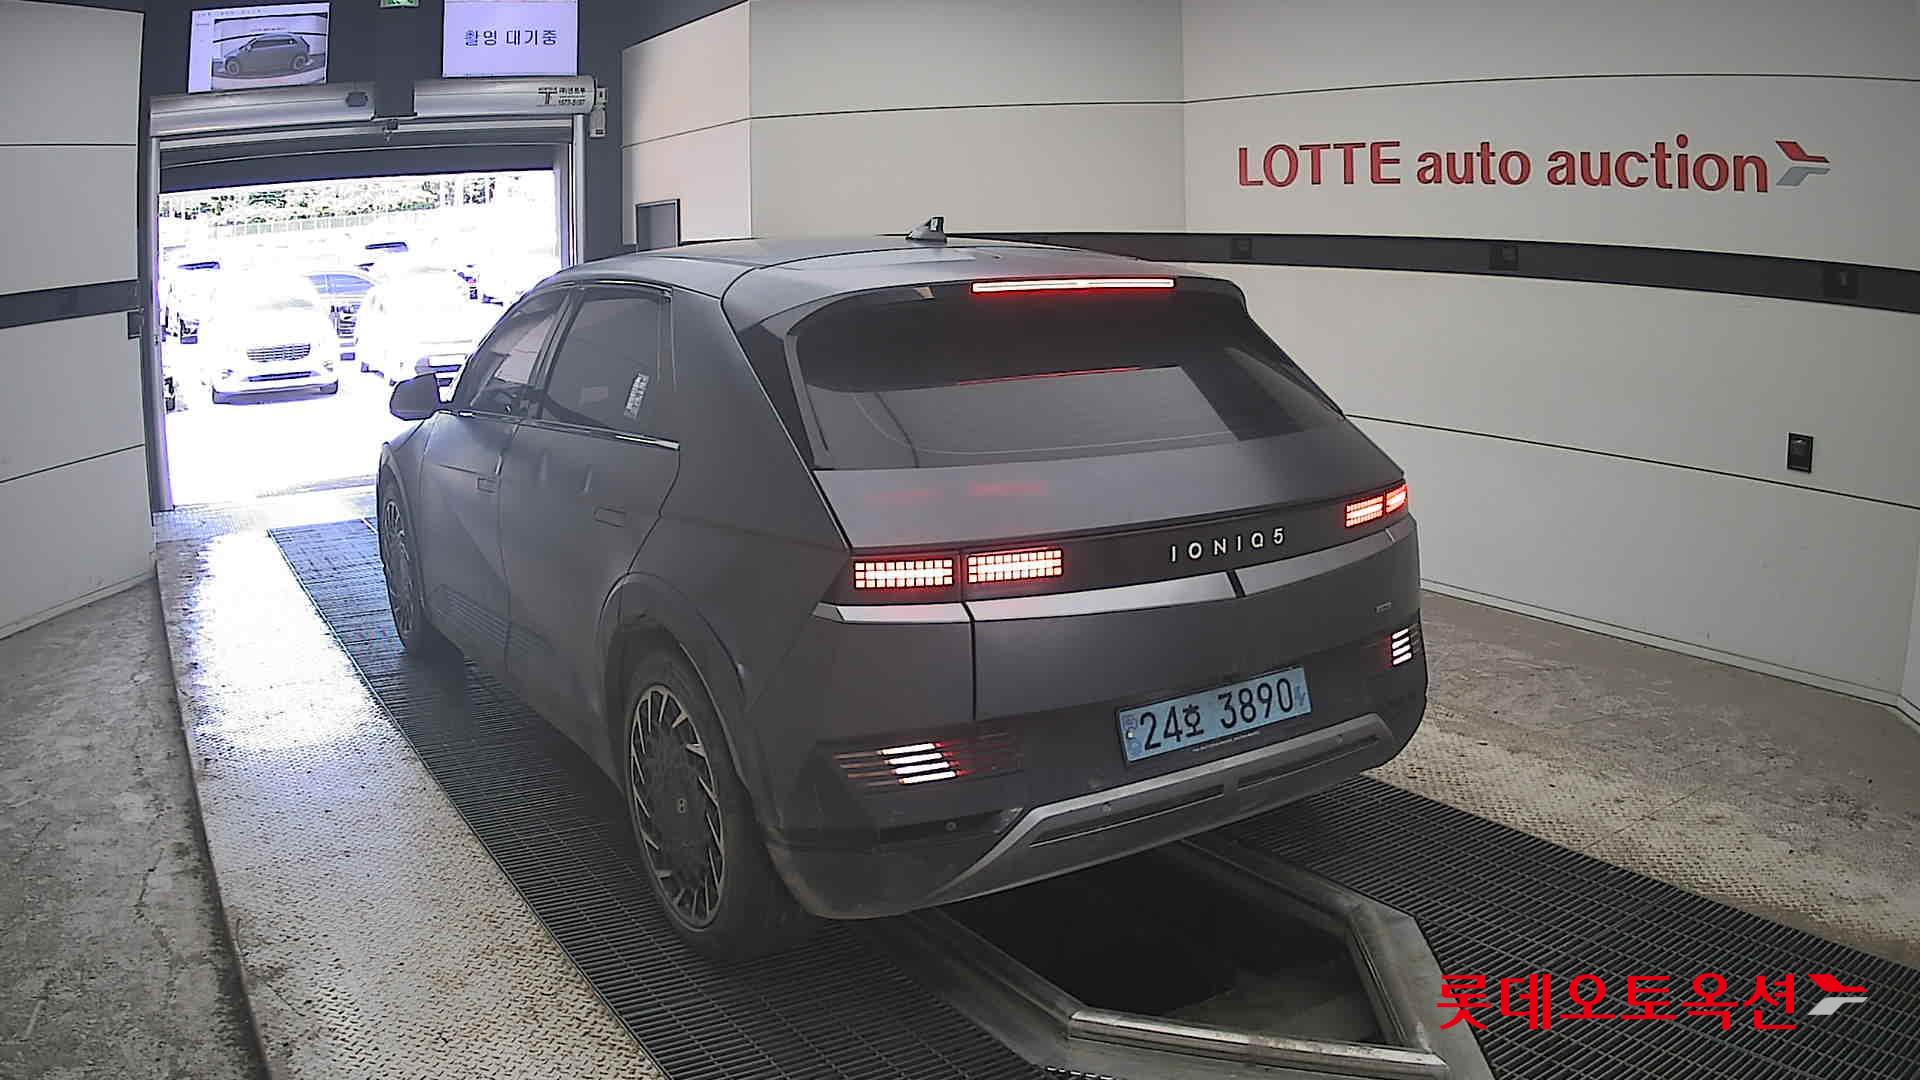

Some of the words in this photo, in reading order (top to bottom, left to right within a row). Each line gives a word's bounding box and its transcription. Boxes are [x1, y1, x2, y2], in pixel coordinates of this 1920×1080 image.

[505, 29, 558, 46] 대기중
[1238, 141, 1401, 187] LOTTE
[1416, 141, 1532, 186] auto
[1546, 134, 1768, 193] auction
[1140, 703, 1205, 751] 24호
[1217, 677, 1294, 729] 3890
